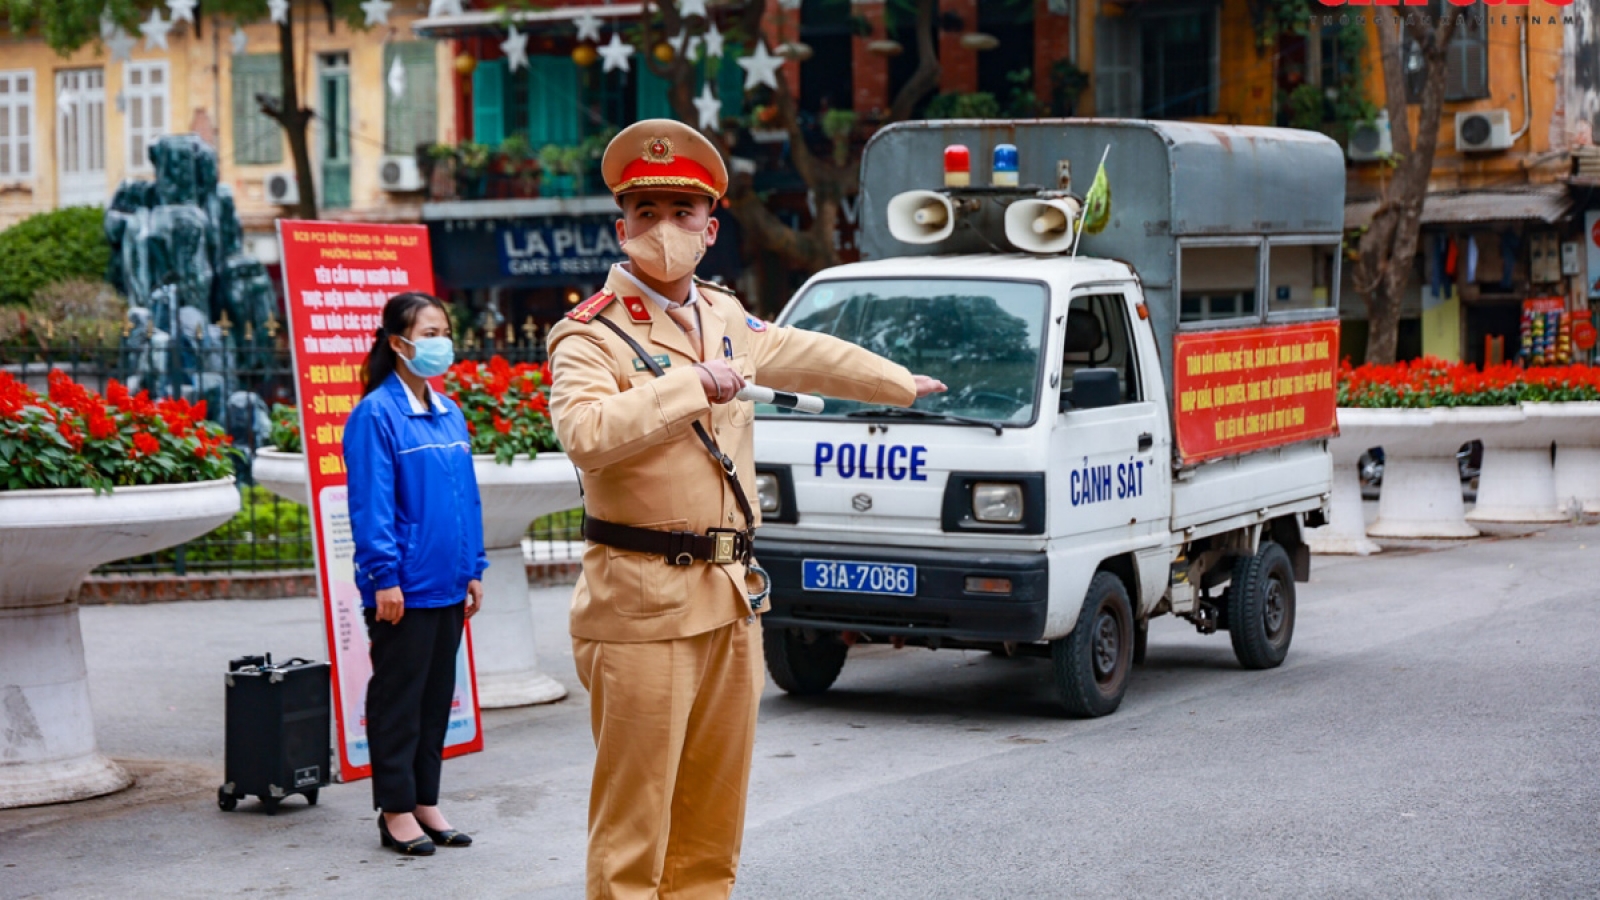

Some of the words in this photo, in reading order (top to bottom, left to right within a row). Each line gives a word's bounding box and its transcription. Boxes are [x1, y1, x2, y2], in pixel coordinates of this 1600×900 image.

[504, 230, 549, 257] LA
[552, 226, 620, 257] PLA
[314, 264, 332, 284] YÊU
[332, 264, 349, 284] CẦU
[815, 442, 927, 481] POLICE
[1070, 456, 1112, 506] CẢNH
[1117, 455, 1144, 499] SÁT
[816, 563, 909, 592] 31A-7086
